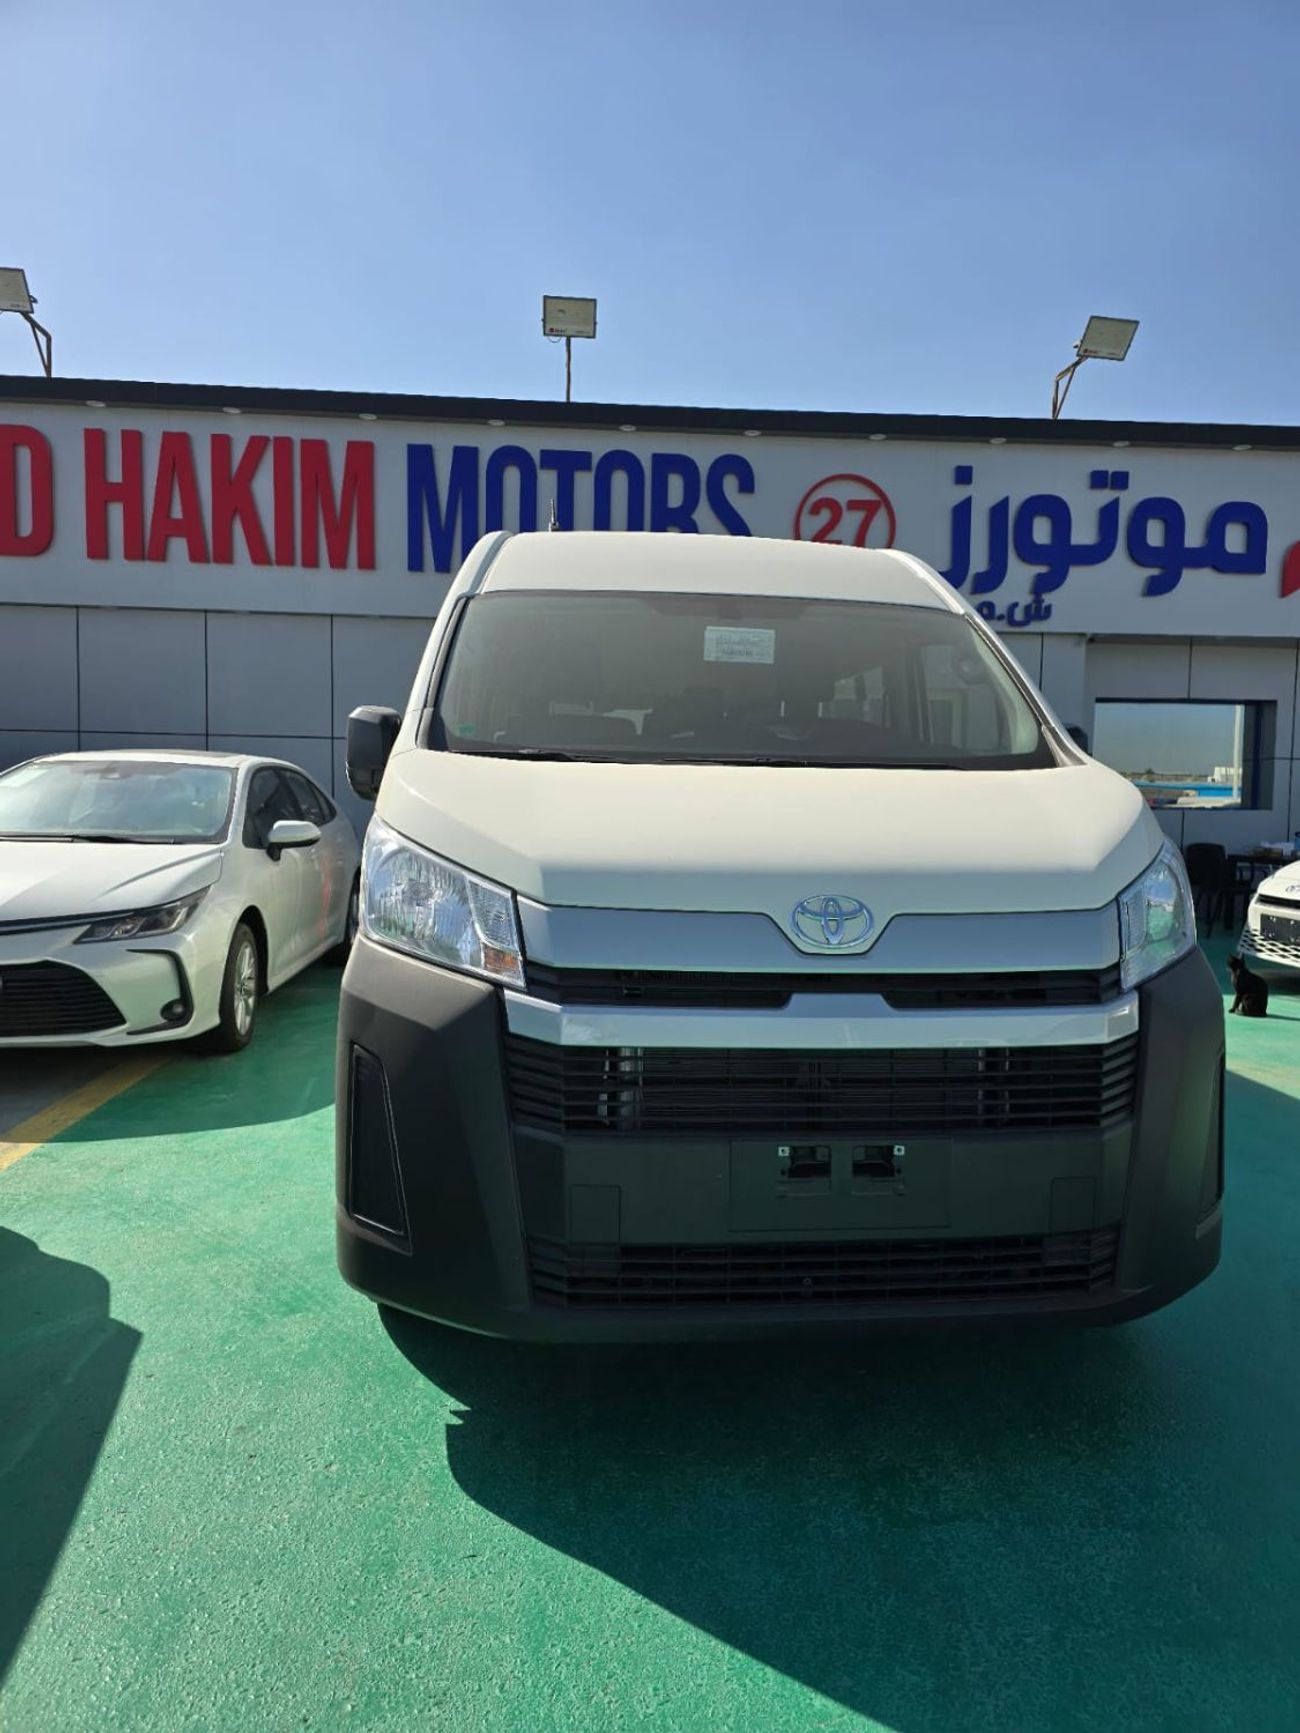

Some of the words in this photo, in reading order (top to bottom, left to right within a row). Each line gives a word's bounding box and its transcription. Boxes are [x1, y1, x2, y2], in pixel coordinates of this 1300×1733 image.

[84, 427, 376, 571] HAKIM
[406, 443, 756, 574] MOTORS
[808, 497, 882, 548] 27
[938, 465, 1268, 598] موتورز
